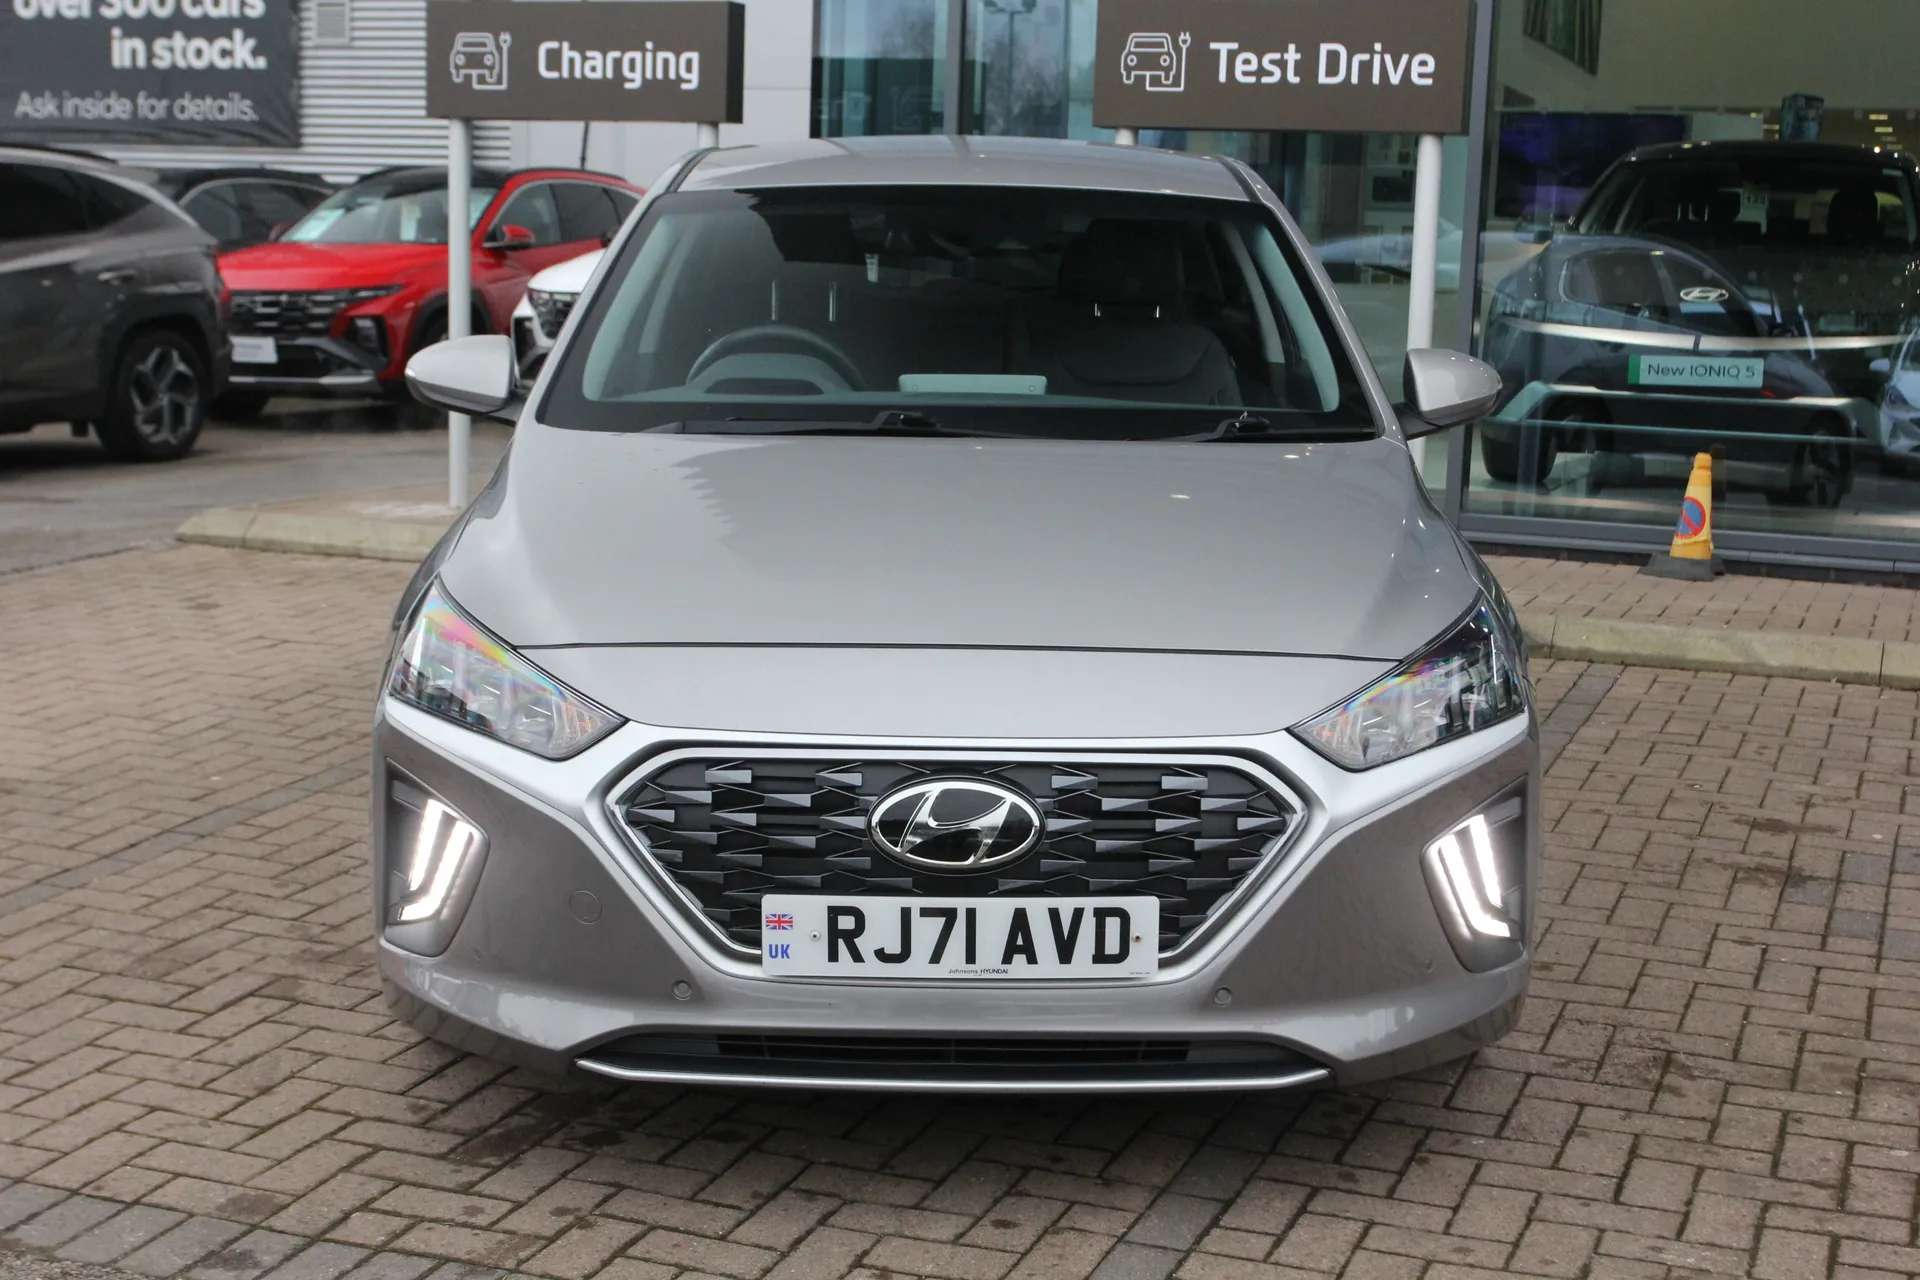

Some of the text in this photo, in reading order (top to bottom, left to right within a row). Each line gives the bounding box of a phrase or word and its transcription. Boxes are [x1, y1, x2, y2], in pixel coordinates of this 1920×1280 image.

[110, 27, 268, 69] in stock.
[538, 41, 700, 90] Charging
[1209, 42, 1436, 85] Test Drive
[14, 90, 260, 121] Ask inside for details.
[1647, 363, 1756, 379] New IONIQ 5
[768, 943, 791, 959] UK
[827, 905, 1131, 965] RJ71 AVD
